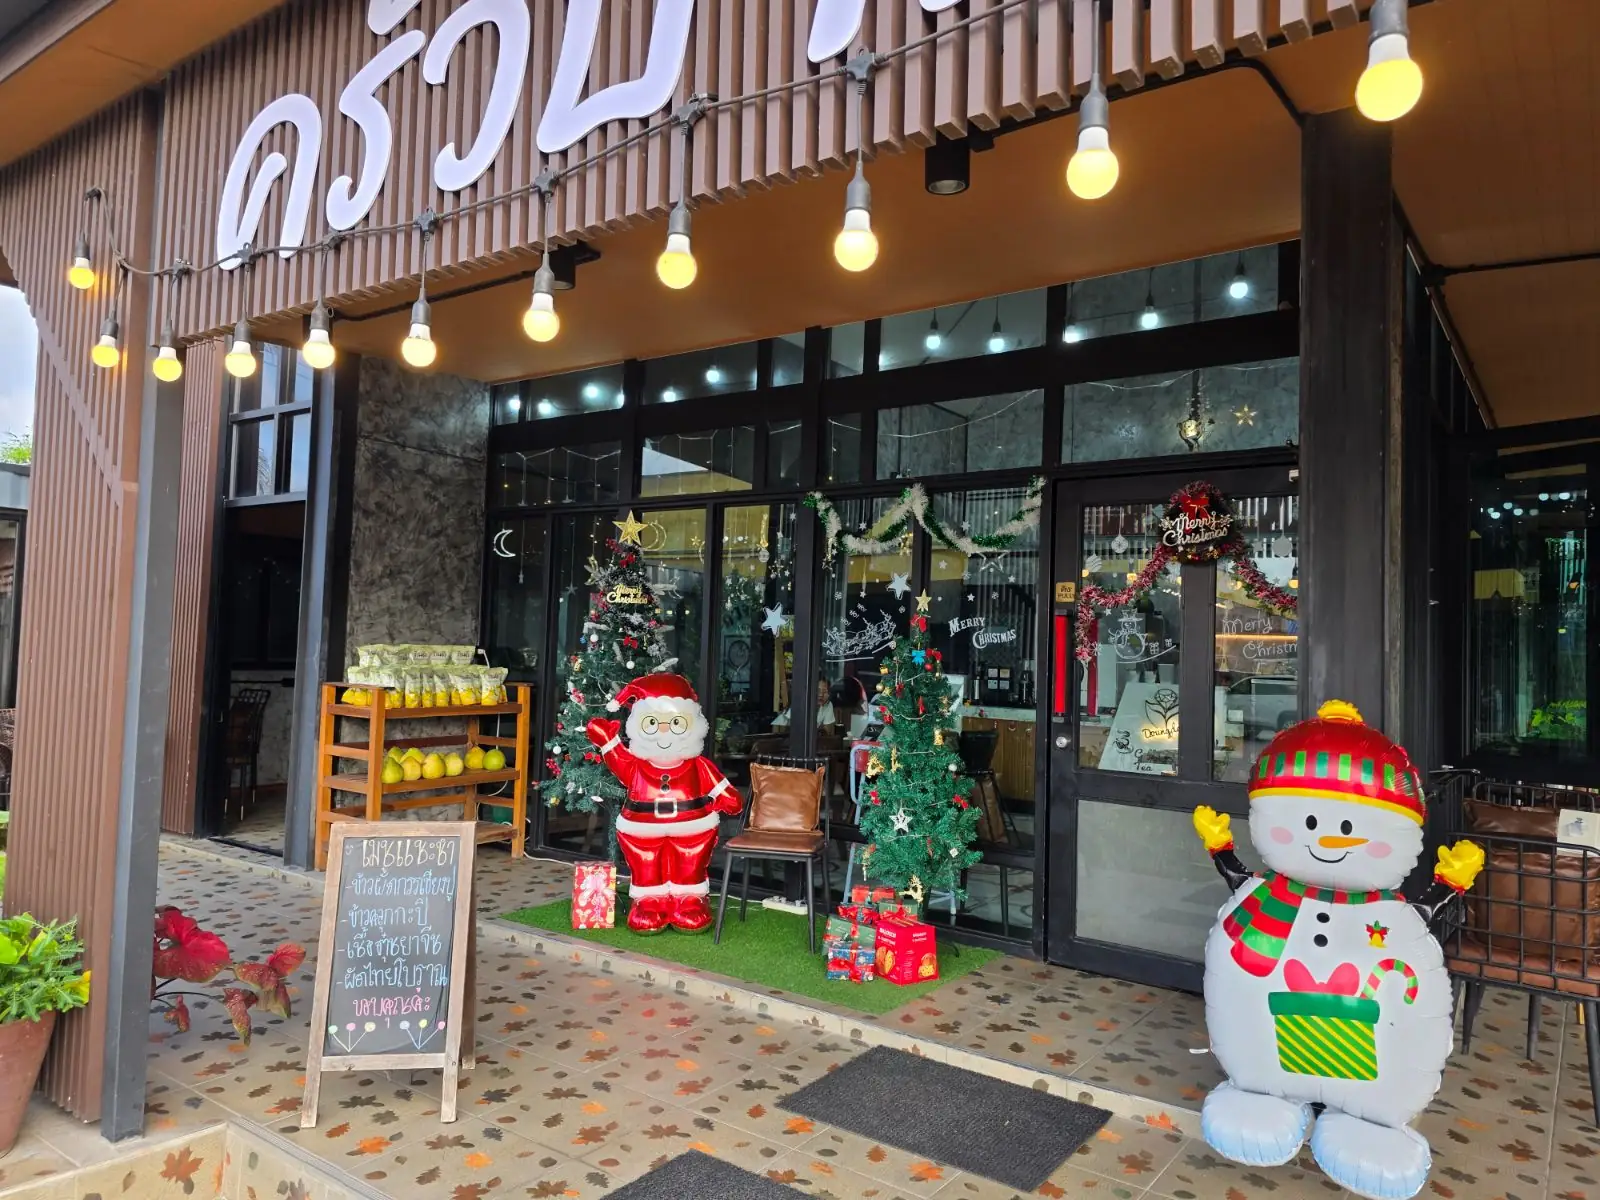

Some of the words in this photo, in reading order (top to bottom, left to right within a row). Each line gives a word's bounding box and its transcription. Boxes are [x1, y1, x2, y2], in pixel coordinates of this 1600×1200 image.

[1171, 511, 1219, 531] Merry
[1163, 527, 1228, 547] Christmas
[948, 617, 985, 637] MERRY
[1222, 617, 1273, 634] Merry
[972, 628, 1017, 649] CHRISTMAS
